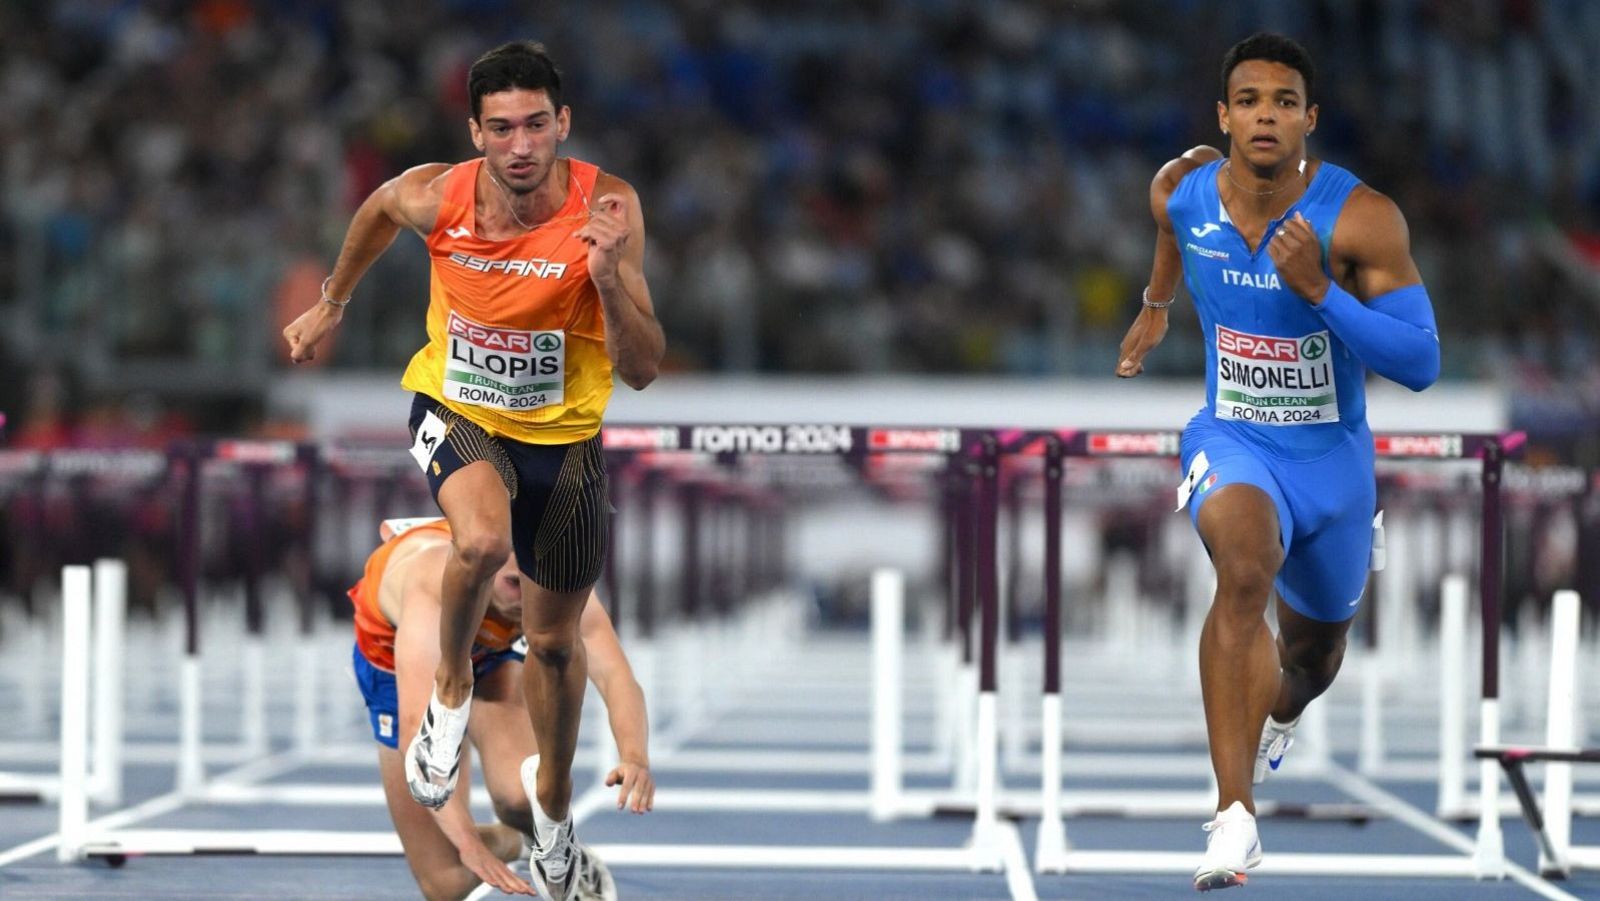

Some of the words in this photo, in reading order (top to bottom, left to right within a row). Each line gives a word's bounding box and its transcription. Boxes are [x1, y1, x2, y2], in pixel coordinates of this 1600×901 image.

[449, 252, 569, 281] ESPAÑA
[1222, 268, 1282, 290] ITALIA
[450, 318, 530, 351] SPAR
[1220, 331, 1297, 360] SPAR
[452, 338, 560, 379] LLOPIS
[475, 375, 499, 388] RUN
[1220, 356, 1330, 390] SIMONELLI
[458, 386, 507, 406] ROMA
[509, 394, 548, 408] 2024
[1245, 395, 1269, 406] RUN
[1232, 406, 1280, 422] ROMA
[1282, 409, 1322, 422] 2024
[691, 426, 783, 453] roma
[785, 425, 853, 453] 2024
